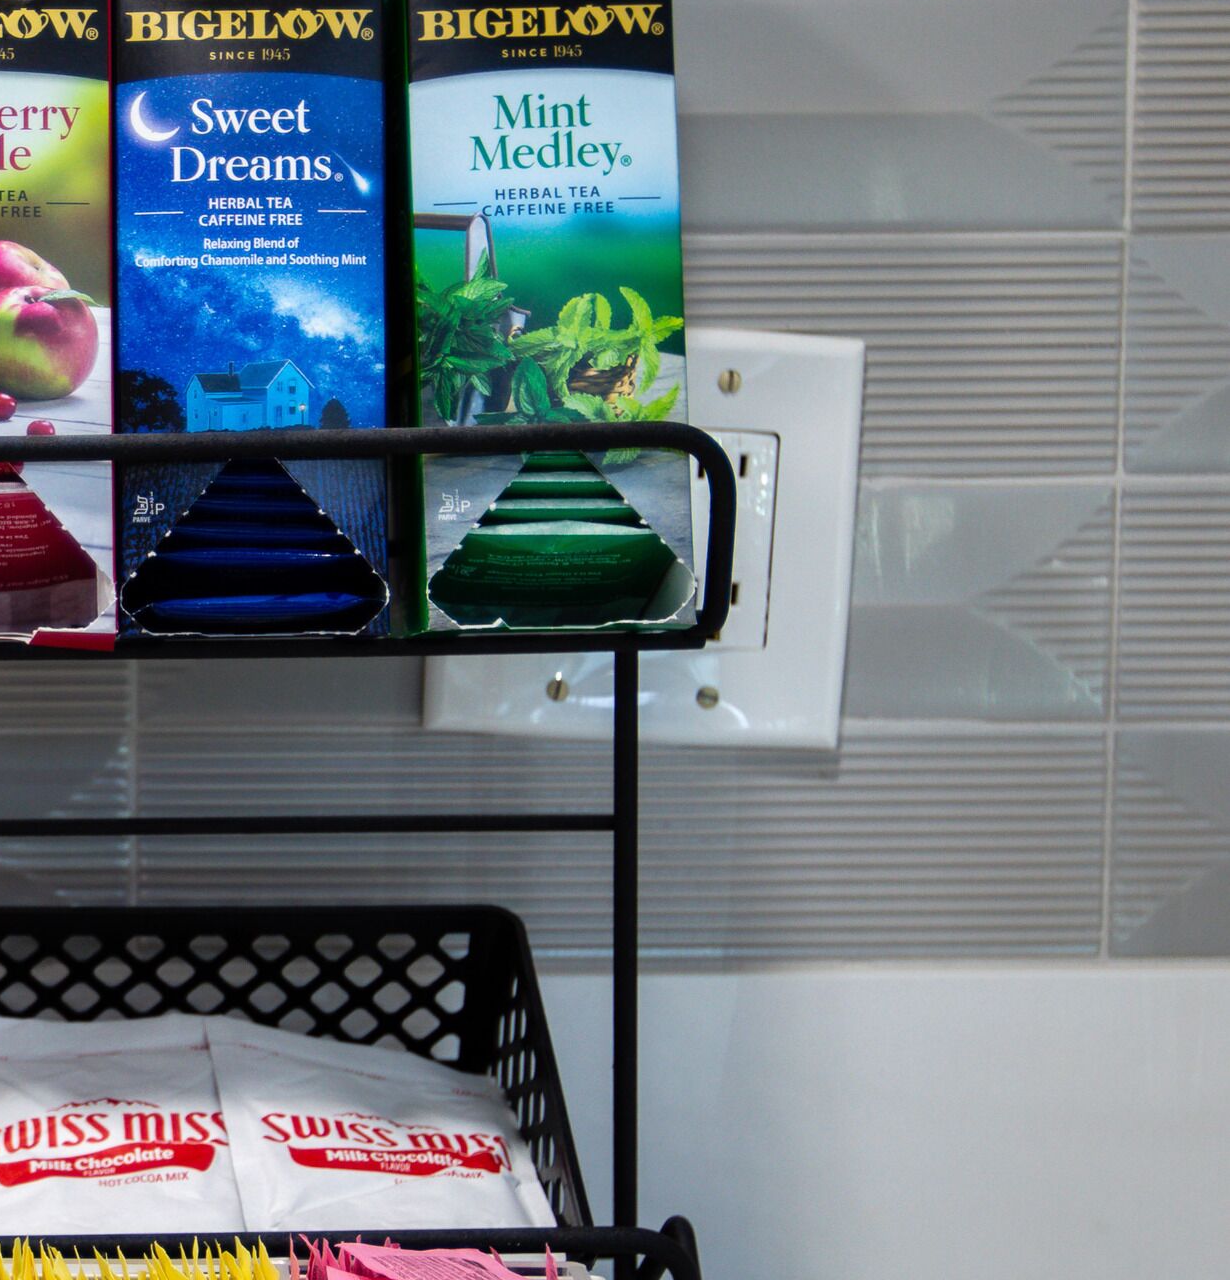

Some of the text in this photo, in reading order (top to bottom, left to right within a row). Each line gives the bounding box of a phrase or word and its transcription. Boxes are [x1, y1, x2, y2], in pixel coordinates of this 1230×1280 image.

[209, 47, 290, 62] SINCE 1945
[501, 44, 582, 58] SINCE 1945
[190, 97, 310, 135] Sweet
[493, 93, 591, 130] Mint
[470, 133, 622, 176] Medley
[170, 146, 332, 184] Dreams
[495, 186, 601, 201] HERBAL TEA
[0, 204, 42, 218] FREE
[208, 197, 292, 210] HERBAL TEA
[483, 200, 614, 217] CAFFEINE FREE
[199, 212, 303, 227] CAFFEINE FREE
[203, 236, 300, 251] Relaxing Blend of
[135, 252, 367, 269] Comforting Chamomile and Soothing Mint
[29, 1147, 174, 1173] Milk Chocolate
[326, 1149, 369, 1162] Milk
[83, 1168, 116, 1176] FLAVOR
[380, 1163, 411, 1172] FLAVOR
[98, 1172, 189, 1187] HOT COCOA MIX
